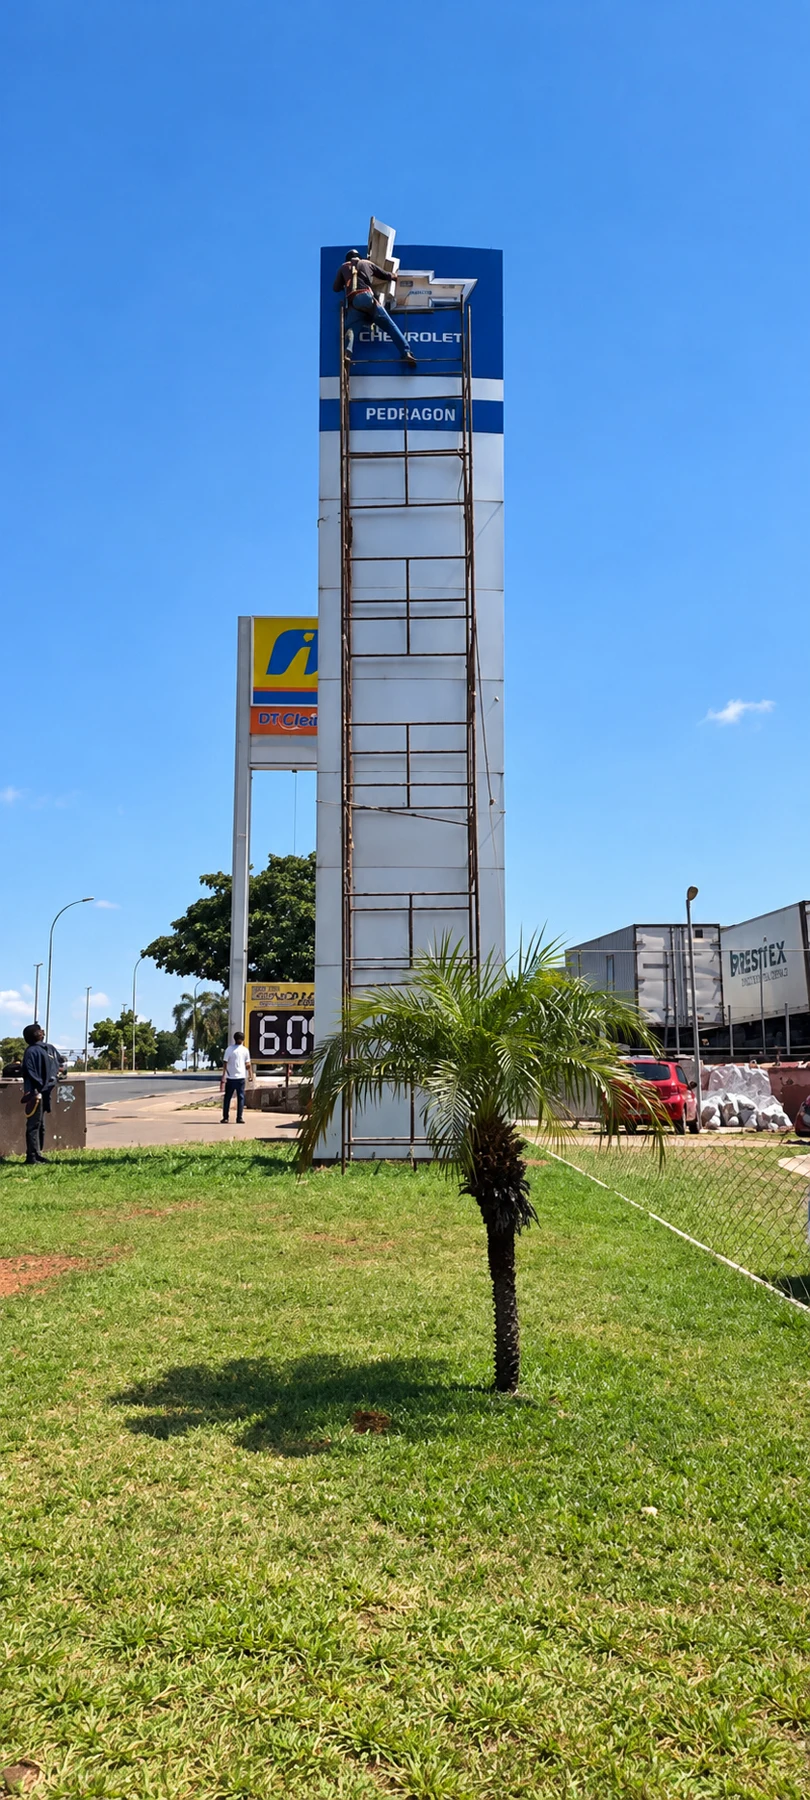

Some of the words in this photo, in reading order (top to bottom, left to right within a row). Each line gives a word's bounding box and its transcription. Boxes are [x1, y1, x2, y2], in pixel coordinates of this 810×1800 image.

[359, 331, 462, 343] CHEROLET
[366, 407, 456, 422] PEDRAGON
[258, 712, 280, 725] DT
